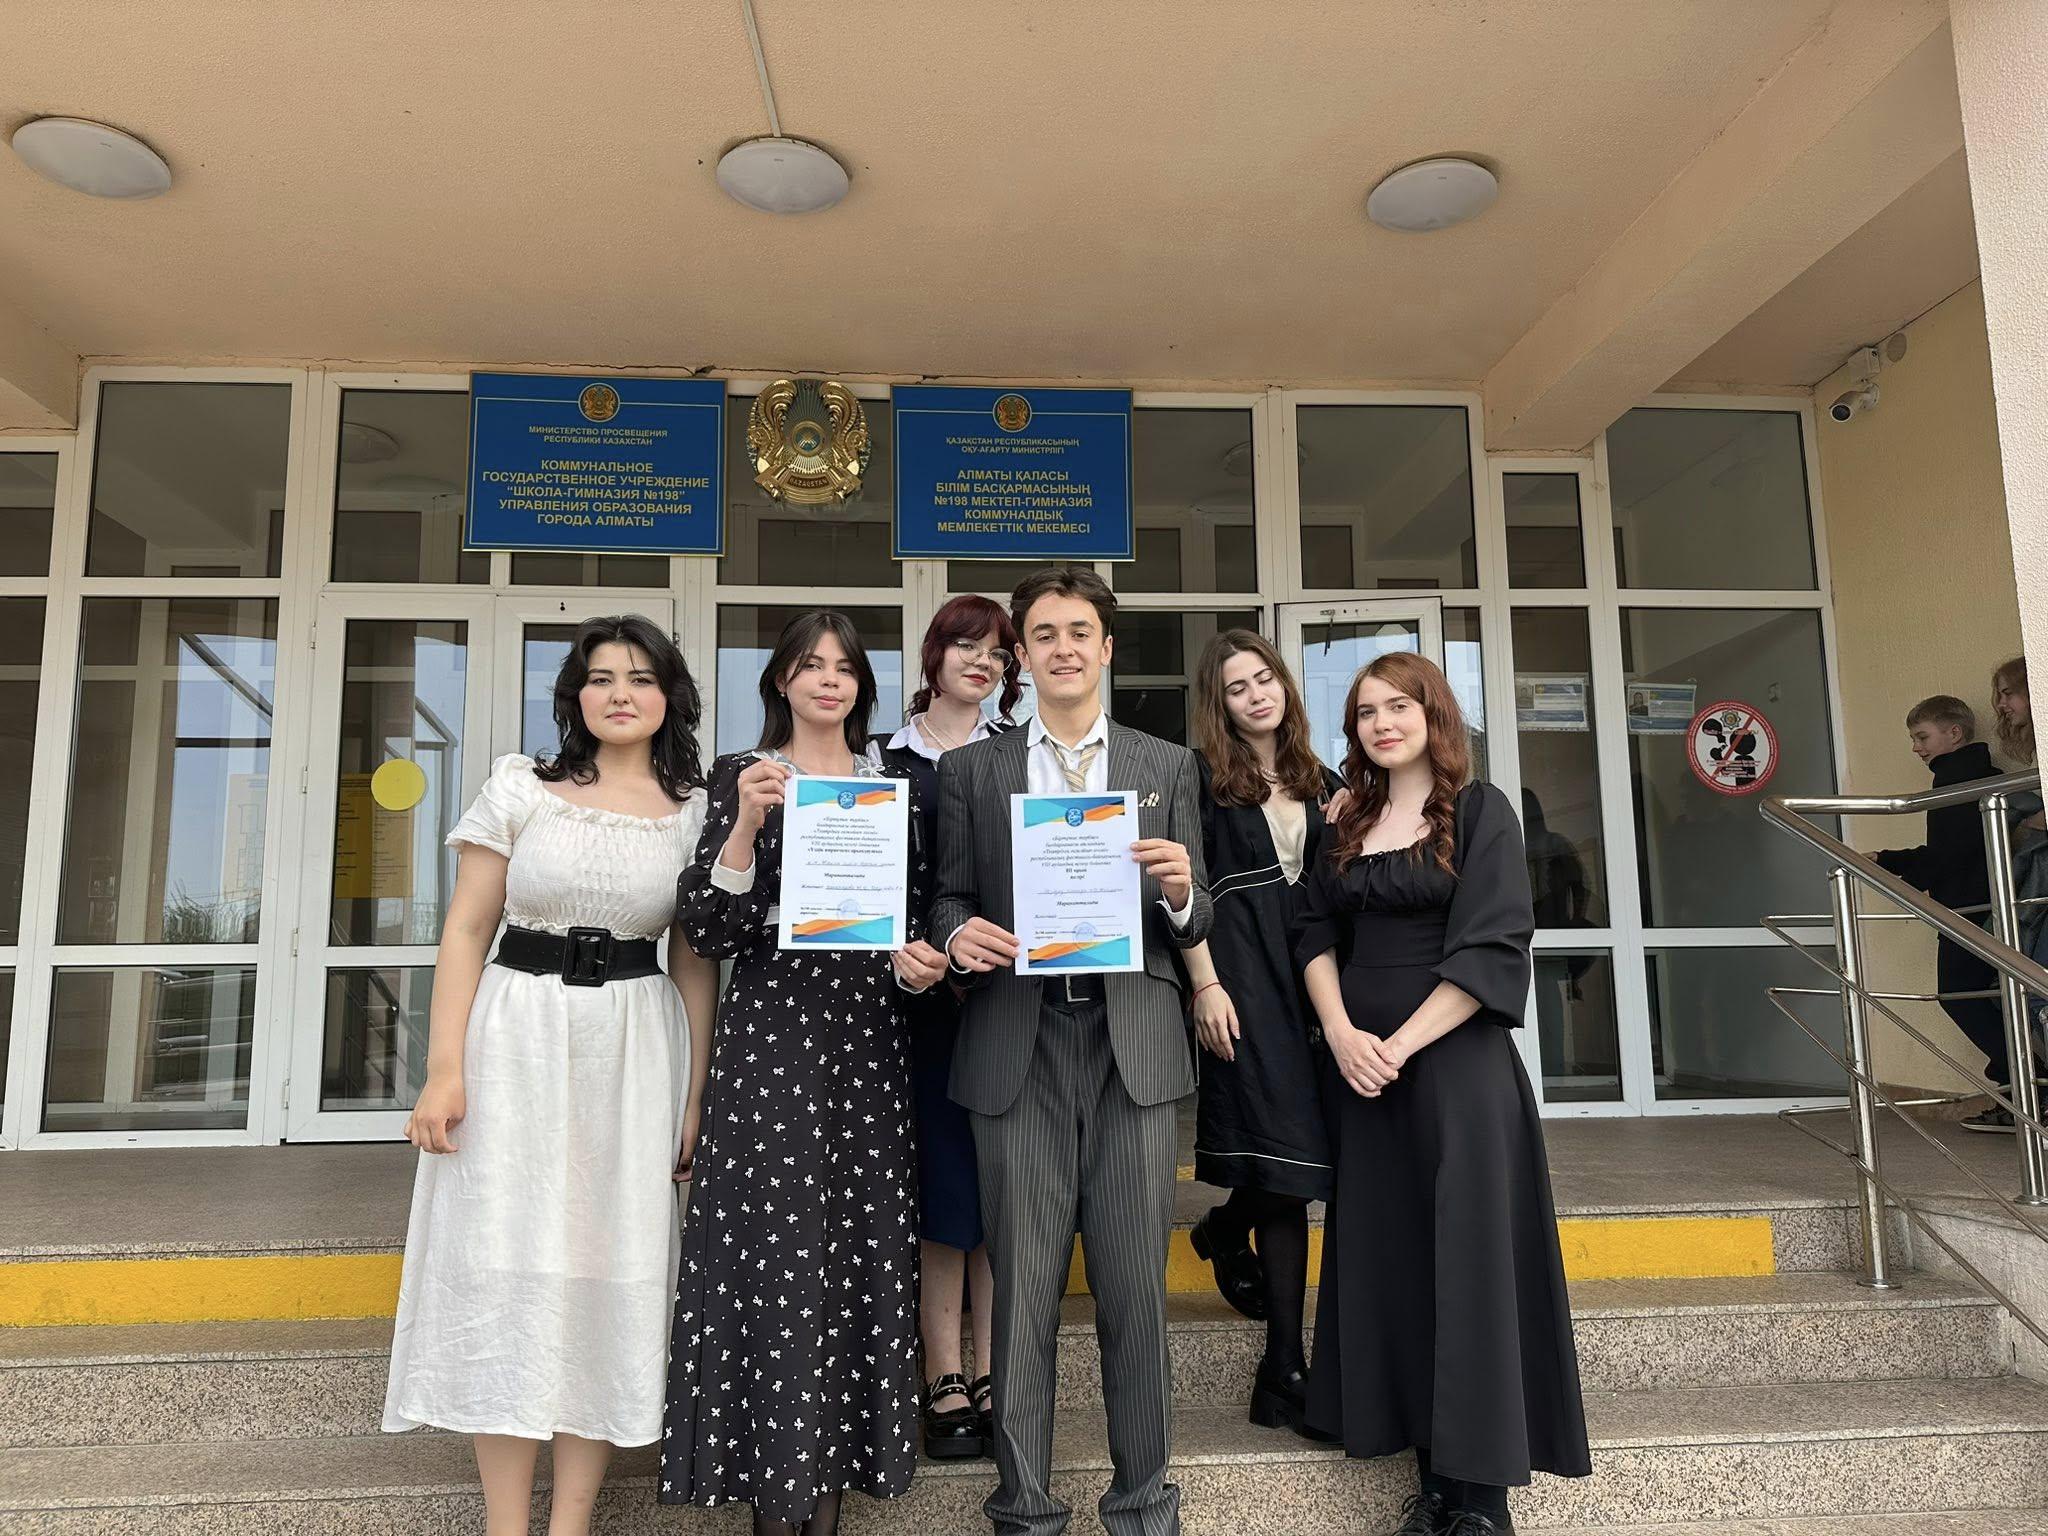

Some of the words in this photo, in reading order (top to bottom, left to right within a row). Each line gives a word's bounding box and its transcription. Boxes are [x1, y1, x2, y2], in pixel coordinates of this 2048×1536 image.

[529, 426, 598, 435] МИНИСТЕРСТВО
[600, 428, 668, 437] ПРОСВЕЩЕНИЯ
[544, 435, 600, 444] РЕСПУБЛИКИ
[603, 437, 653, 445] КАЗАХСТАН
[946, 437, 993, 446] ҚАЗАҚСТАН
[994, 438, 1079, 447] РЕСПУБЛИКАСЫНЫҢ
[962, 446, 1010, 454] ОҚУ-АҒАРТУ
[541, 460, 653, 473] КОММУНАЛЬНОЕ
[483, 471, 616, 486] ГОСУДАРСТВЕННОЕ
[620, 475, 709, 489] УЧРЕЖДЕНИЕ
[957, 470, 1012, 481] АЛМАТЫ
[1016, 471, 1068, 483] ҚАЛАСЫ
[936, 483, 970, 493] БІЛІМ
[974, 483, 1091, 495] БАСҚАРМАСЫНЫҢ
[499, 500, 588, 512] УПРАВЛЕНИЯ
[593, 502, 692, 514] ОБРАЗОВАНИЯ
[934, 496, 968, 506] №198
[972, 496, 1092, 507] МЕКТЕП-ГИМНАЗИЯ
[537, 514, 591, 527] ГОРОДА
[595, 516, 654, 527] АЛМАТЫ
[965, 509, 1063, 522] КОММУНАЛДЫҚ
[938, 522, 1023, 533] МЕМЛЕКЕТТІК
[1027, 523, 1090, 533] МЕКЕМЕСІ
